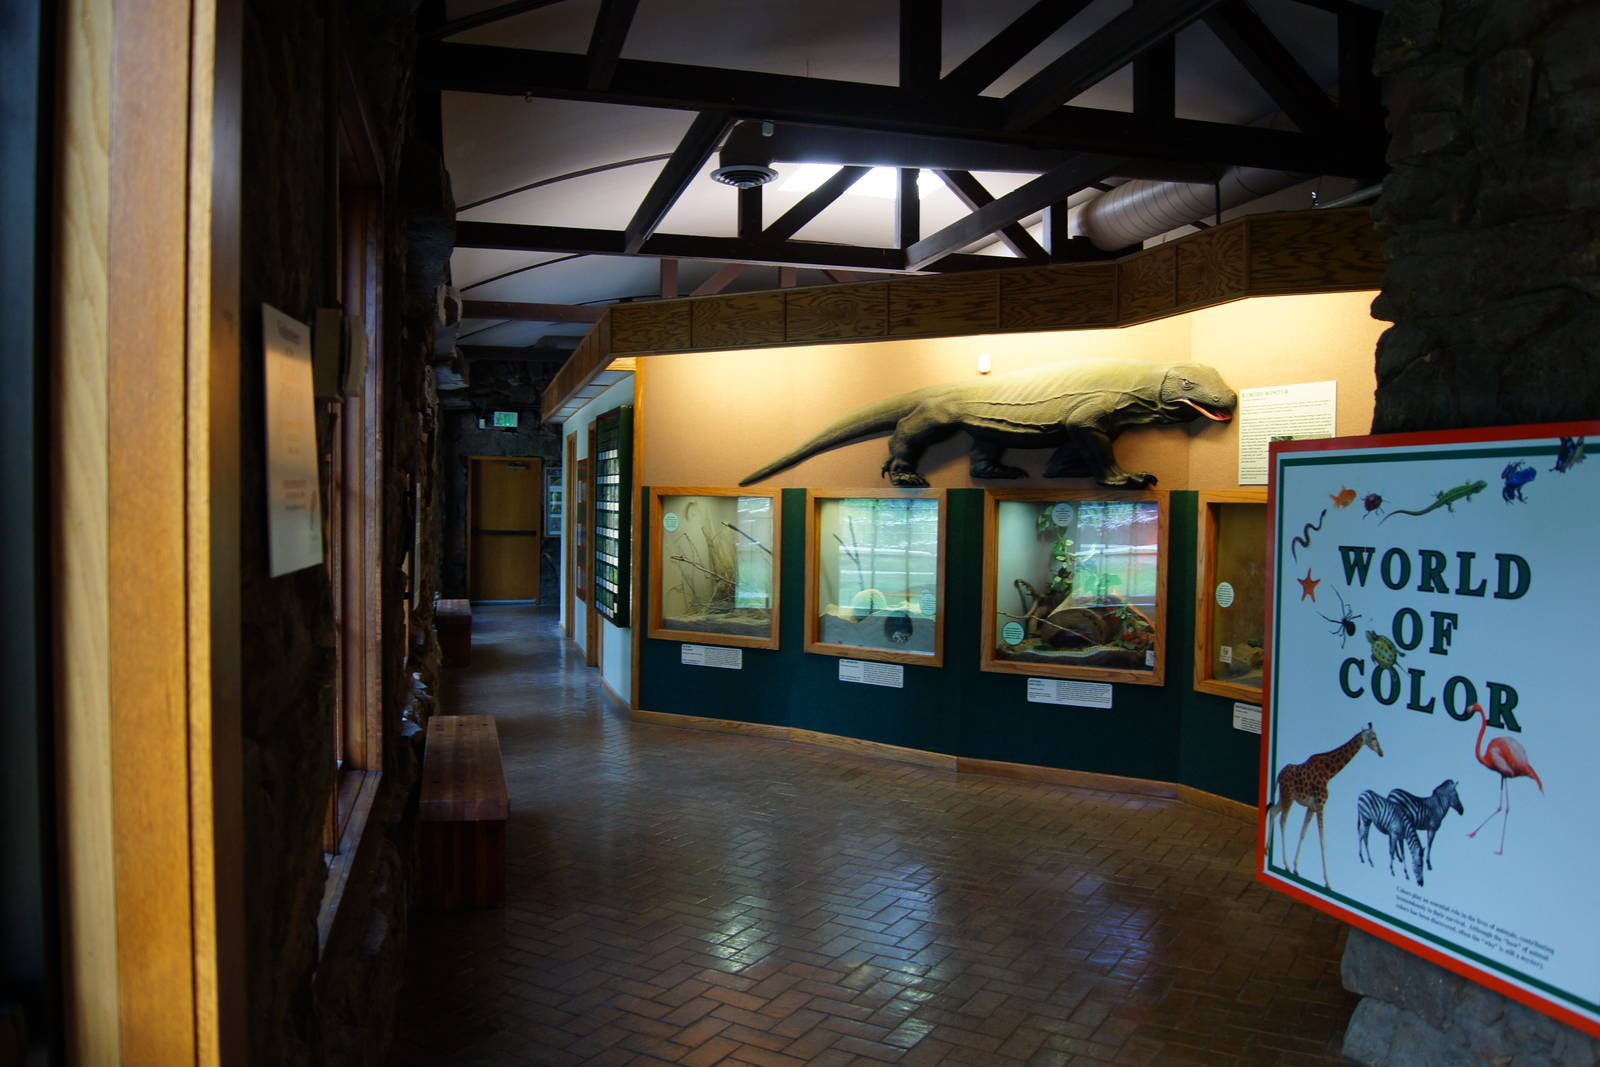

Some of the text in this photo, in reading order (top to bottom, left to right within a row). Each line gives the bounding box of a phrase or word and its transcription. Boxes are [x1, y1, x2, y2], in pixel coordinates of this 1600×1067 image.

[1338, 545, 1532, 600] WORLD
[1392, 607, 1458, 656] OF
[1339, 657, 1522, 733] COLOR
